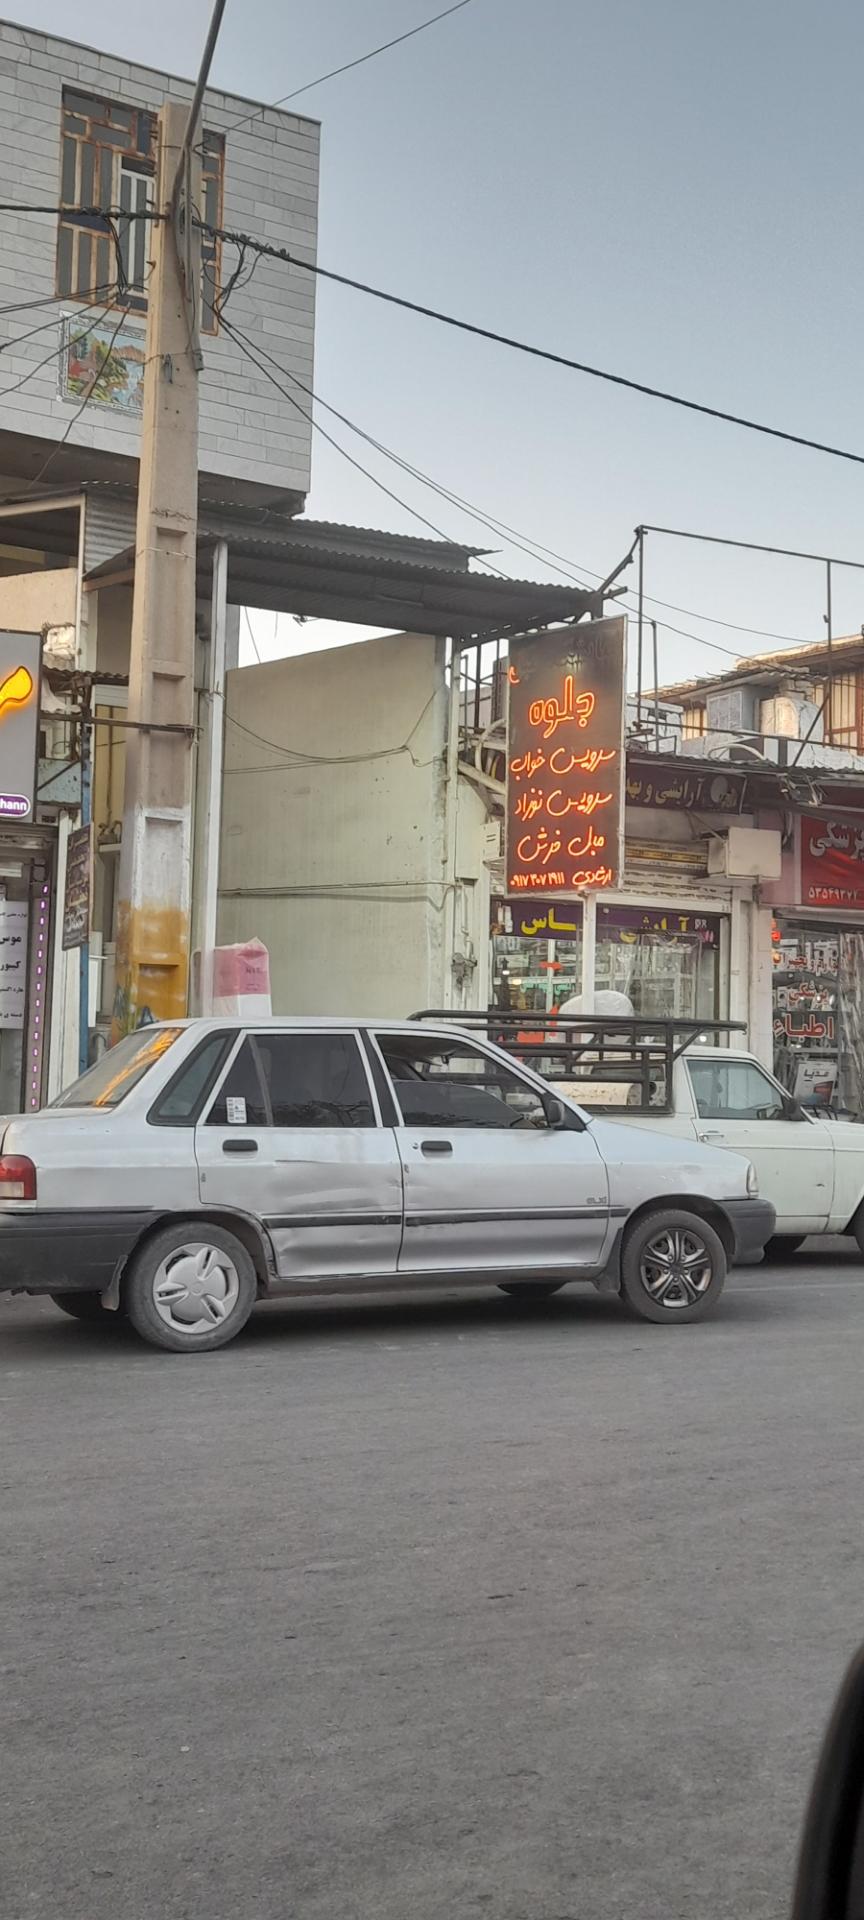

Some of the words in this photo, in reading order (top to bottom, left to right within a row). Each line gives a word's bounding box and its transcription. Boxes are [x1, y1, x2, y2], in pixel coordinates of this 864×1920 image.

[528, 674, 595, 739] جلوه
[510, 748, 545, 781] خواب
[549, 747, 616, 774] سرویس
[514, 787, 543, 822] نوزاد
[546, 789, 613, 817] سرویس
[517, 827, 561, 865] فرش
[567, 826, 605, 857] مبل
[571, 866, 612, 886] ارشادی
